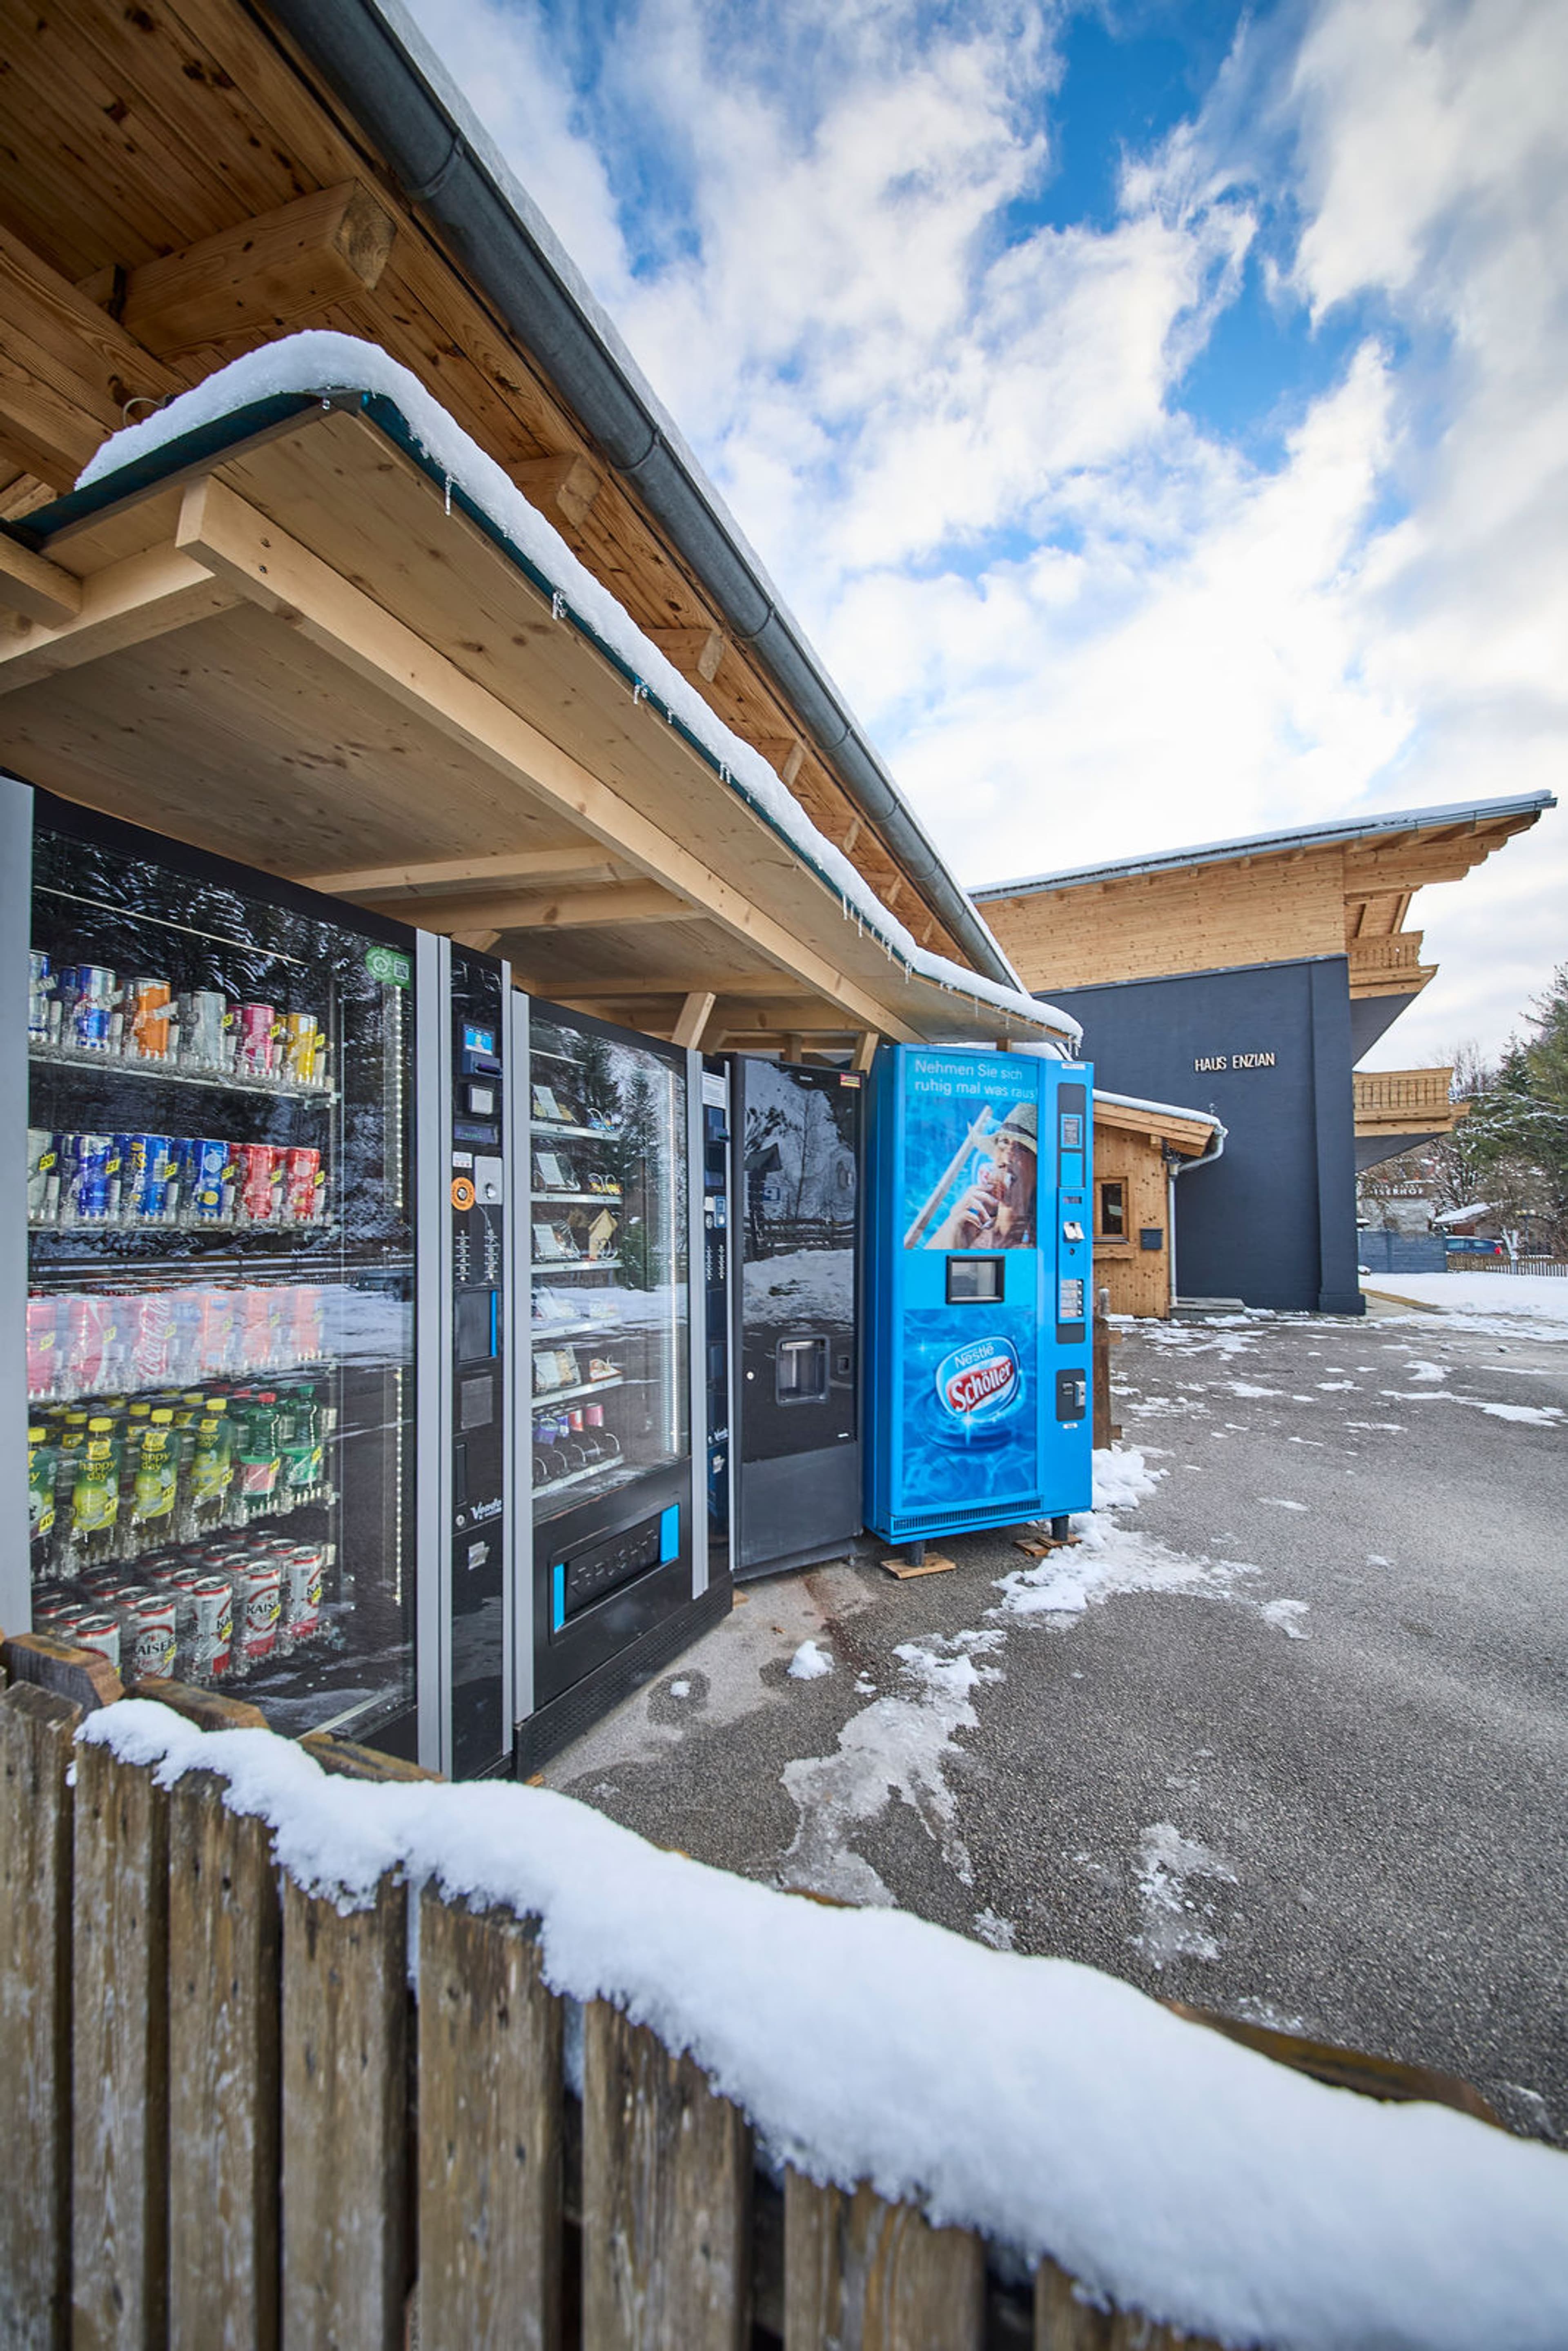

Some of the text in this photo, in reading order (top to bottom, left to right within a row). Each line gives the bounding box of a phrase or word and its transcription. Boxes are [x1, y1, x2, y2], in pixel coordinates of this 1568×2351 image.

[915, 1060, 1022, 1080] Nehmen Sie sich
[1195, 1052, 1275, 1071] HAUS ENZIAN
[915, 1079, 951, 1095] ruhig
[956, 1082, 980, 1094] mal
[984, 1086, 1008, 1097] was
[954, 1342, 994, 1369] Nestlé
[951, 1362, 1011, 1412] Schöller
[86, 1471, 108, 1482] day
[247, 1601, 278, 1614] KAIS
